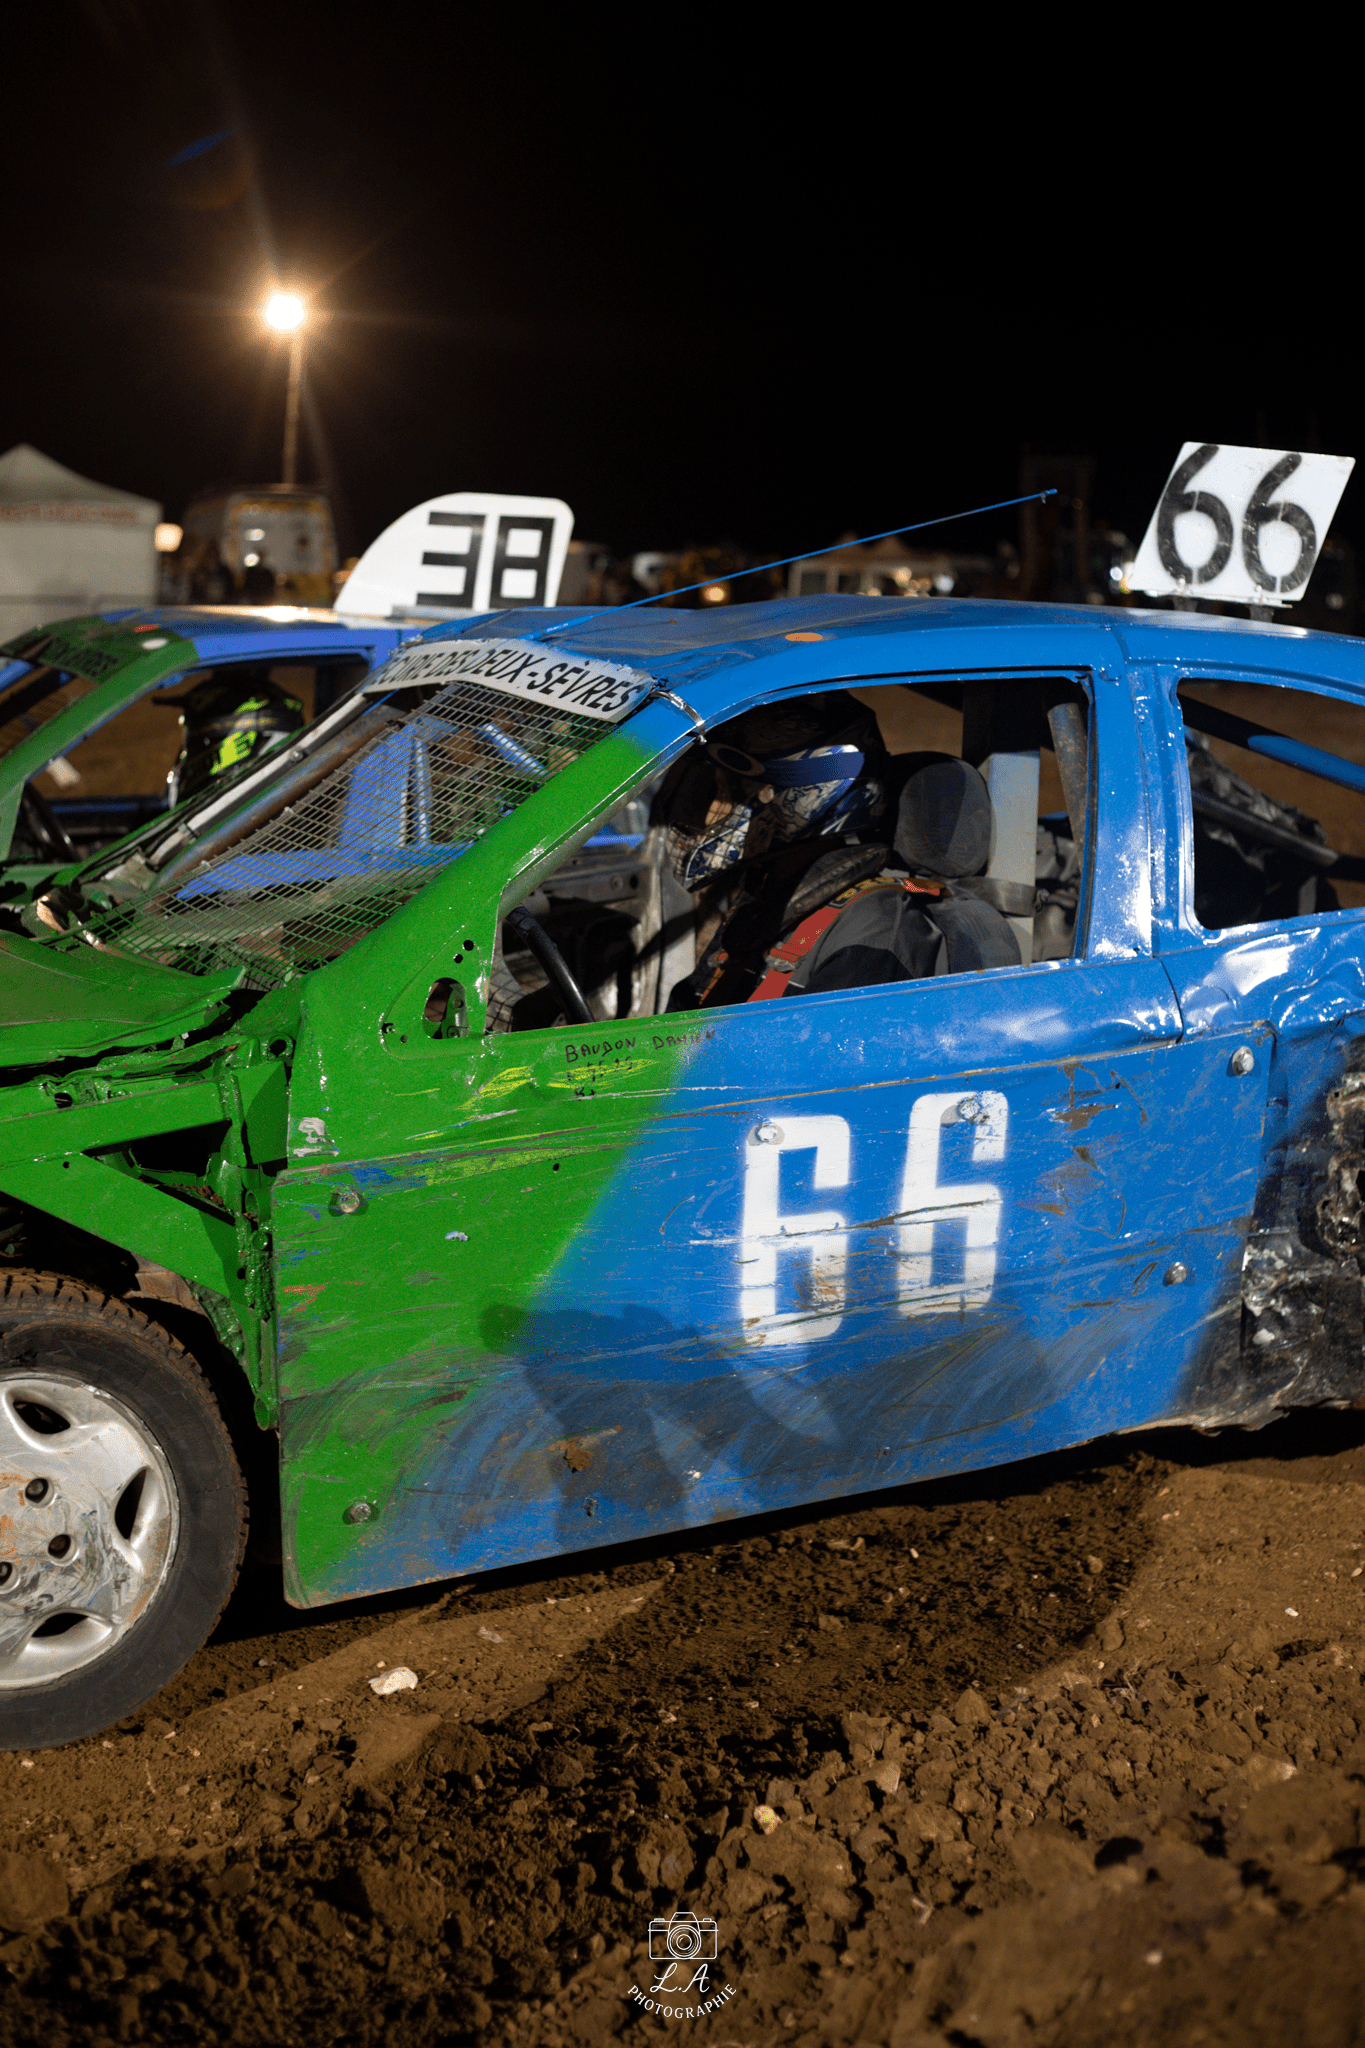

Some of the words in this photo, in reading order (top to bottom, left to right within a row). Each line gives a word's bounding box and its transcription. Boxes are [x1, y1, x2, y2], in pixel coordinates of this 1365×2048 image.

[416, 511, 556, 609] 38
[1157, 443, 1317, 594] 66
[423, 649, 480, 679] DES
[565, 1037, 636, 1063] BAUDON
[741, 1090, 1009, 1345] 66
